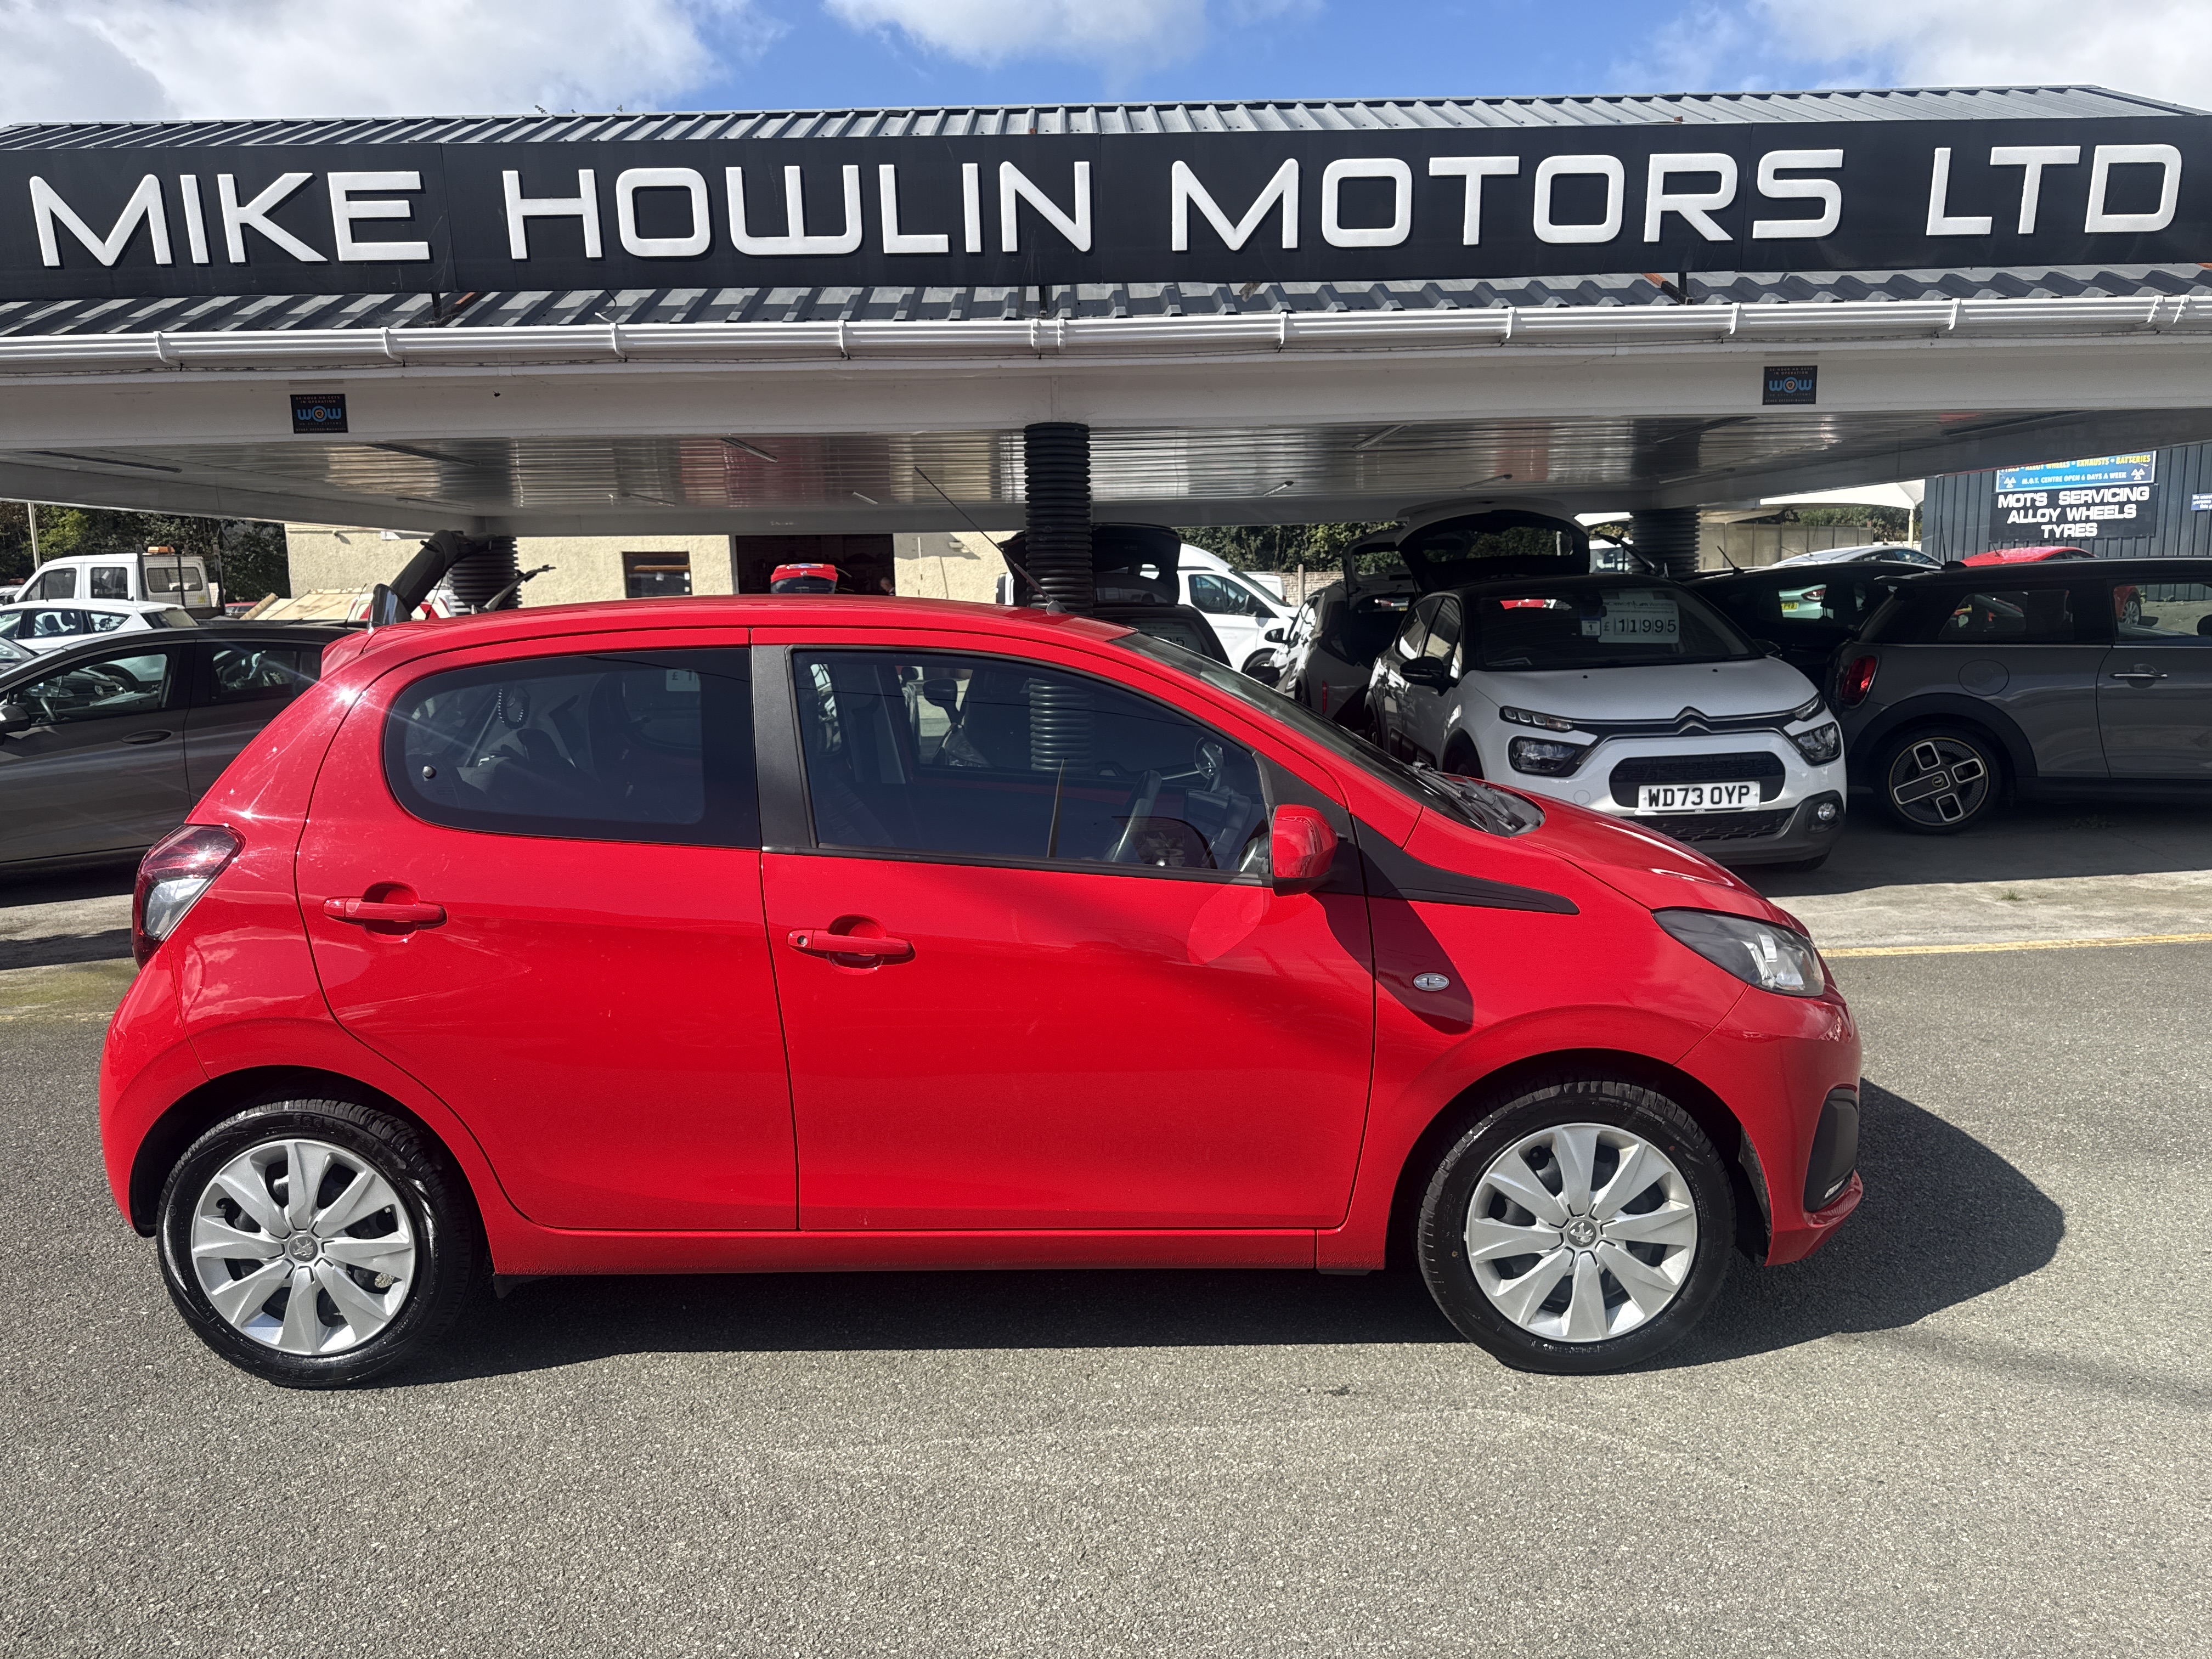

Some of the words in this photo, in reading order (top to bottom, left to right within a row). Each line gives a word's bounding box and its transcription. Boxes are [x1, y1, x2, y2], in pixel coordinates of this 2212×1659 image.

[30, 171, 429, 266] MIKE
[503, 161, 1091, 259] HOWLIN
[1172, 149, 1843, 251] MOTORS
[1926, 144, 2181, 235] LTD
[2046, 461, 2070, 469] WHEELS
[2076, 458, 2109, 467] EXHAUSTS
[2115, 455, 2151, 464] BATTERIES
[2040, 475, 2063, 483] CENTRE
[1998, 492, 2047, 508] MOT'S
[2058, 486, 2150, 505] SERVICING
[2007, 507, 2062, 524] ALLOY
[2066, 504, 2137, 521] WHEELS
[2041, 522, 2098, 538] TYRES
[1618, 619, 1676, 633] 11995
[1647, 787, 1704, 807] WD73
